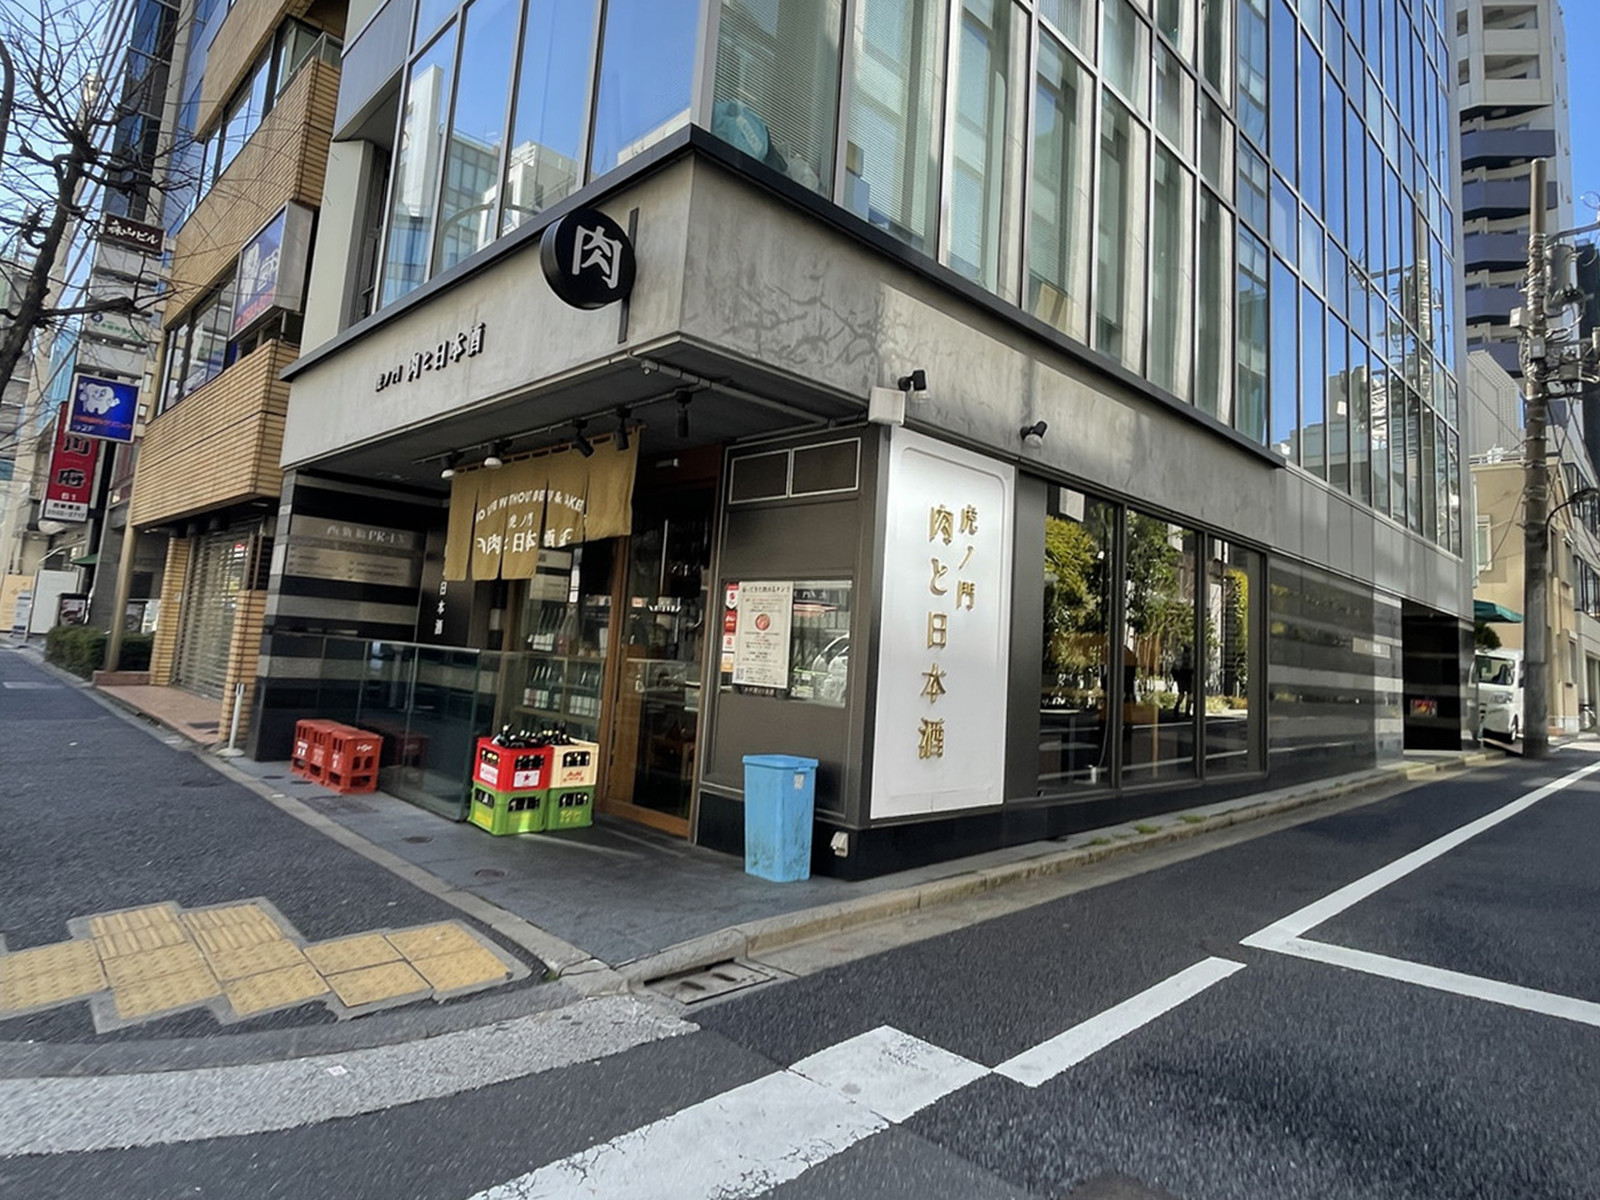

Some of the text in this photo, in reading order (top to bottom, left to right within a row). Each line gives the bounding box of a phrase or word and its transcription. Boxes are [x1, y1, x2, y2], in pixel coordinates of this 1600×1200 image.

[571, 224, 624, 290] 肉
[955, 504, 979, 611] 虎ノ門
[917, 504, 955, 760] 肉と日本酒
